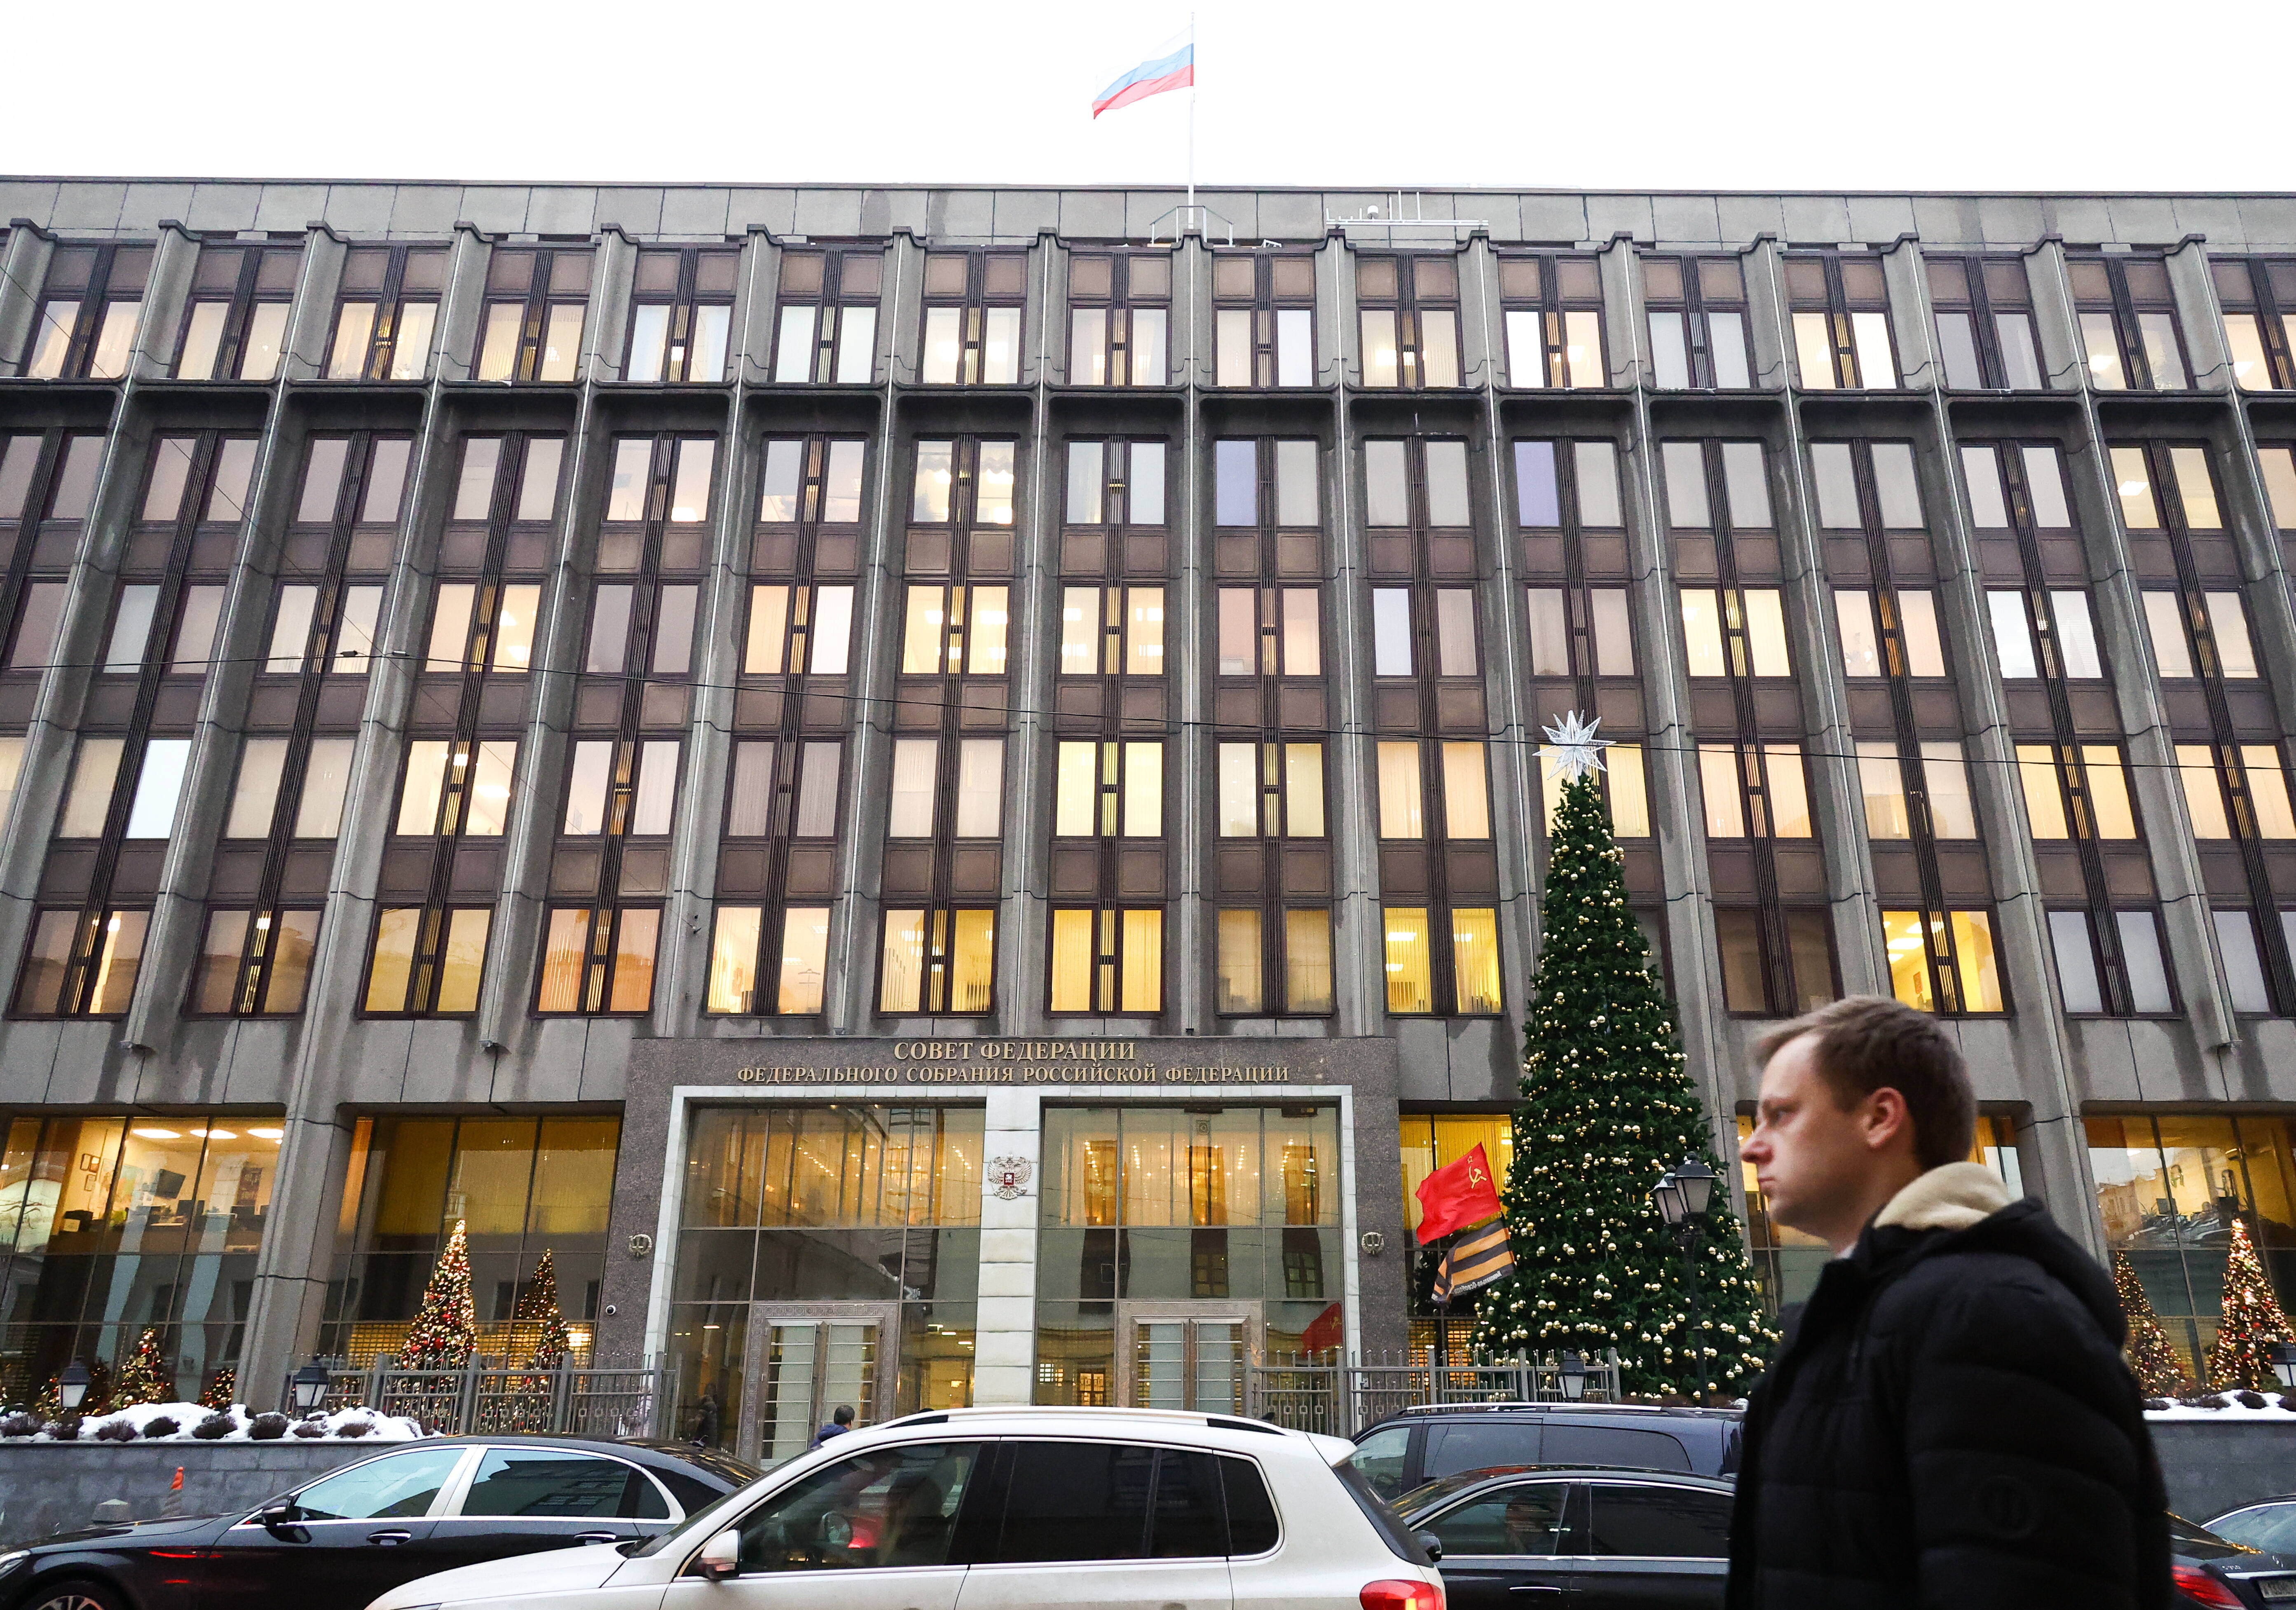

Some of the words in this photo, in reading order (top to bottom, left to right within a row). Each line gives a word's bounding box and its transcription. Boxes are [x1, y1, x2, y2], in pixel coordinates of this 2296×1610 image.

[894, 1042, 973, 1060] СОВЕТ
[980, 1042, 1135, 1062] ФЕДЕРАЦИИ
[738, 1067, 897, 1084] ФЕДЕРАЛЬНОГО
[907, 1067, 1014, 1082] СОБРАНИЯ
[1023, 1063, 1156, 1082] РОССИЙСКОЙ
[1165, 1067, 1289, 1084] ФЕДЕРАЦИИ
